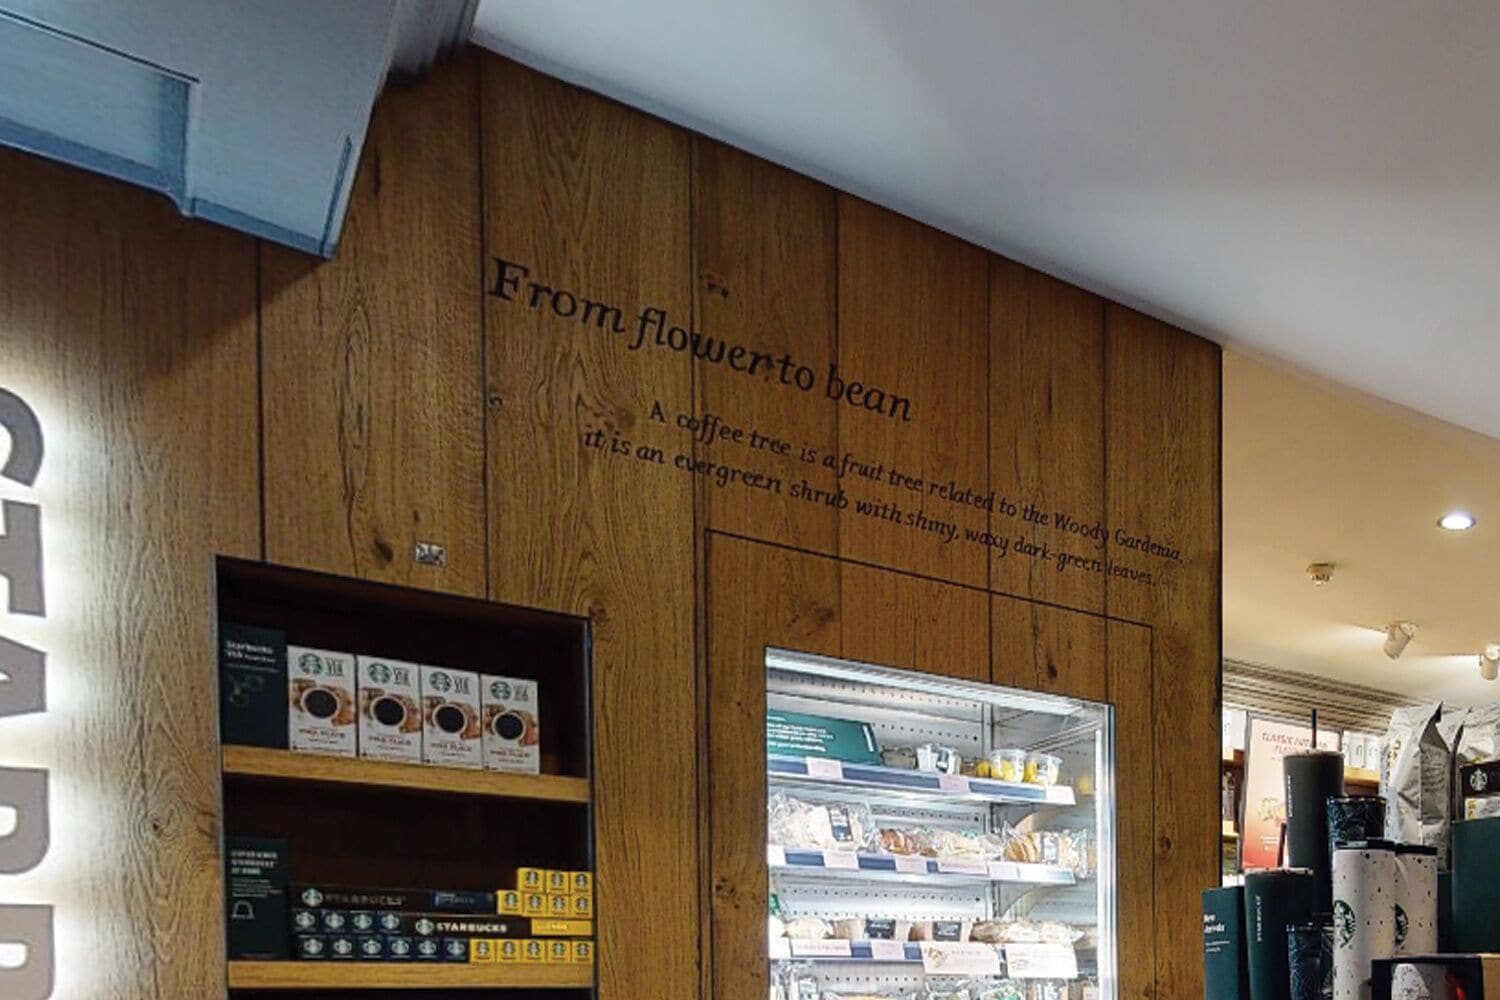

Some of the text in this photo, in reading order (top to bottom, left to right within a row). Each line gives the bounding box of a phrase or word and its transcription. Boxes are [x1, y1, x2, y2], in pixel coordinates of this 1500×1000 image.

[488, 257, 911, 422] From flower to bean
[583, 424, 604, 450] it
[610, 432, 632, 457] is
[636, 445, 665, 465] an
[674, 452, 783, 494] evergreen
[790, 479, 848, 509] shrub
[855, 500, 901, 524] with
[904, 504, 960, 544] shiny,
[964, 525, 1009, 558] waxy
[1014, 536, 1102, 572] dark-green
[649, 401, 666, 423] A
[677, 413, 743, 445] coffee
[750, 429, 792, 457] tree
[800, 442, 816, 464] is
[822, 453, 837, 470] a
[835, 452, 884, 482] fruit
[887, 468, 923, 492] tree
[929, 480, 995, 514] related
[999, 497, 1017, 518] to
[1022, 504, 1049, 526] the
[1053, 511, 1110, 549] Woody
[437, 921, 508, 933] STARBUCKS
